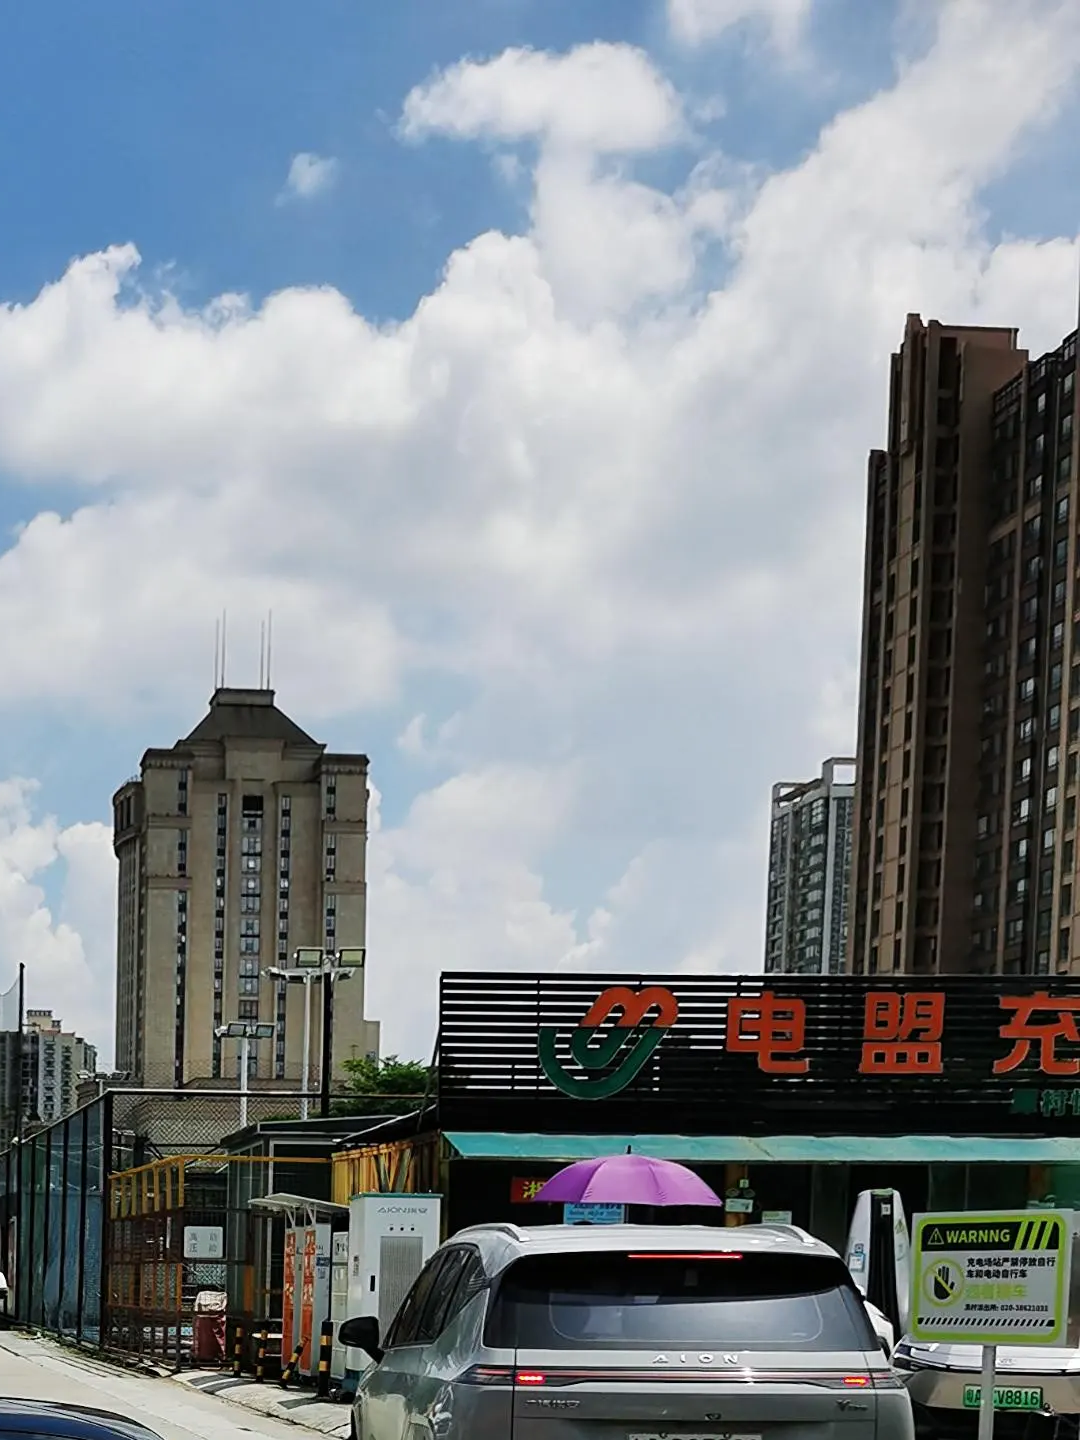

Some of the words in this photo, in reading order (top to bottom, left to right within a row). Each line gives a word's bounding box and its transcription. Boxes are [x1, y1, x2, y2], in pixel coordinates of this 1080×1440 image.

[724, 990, 1080, 1075] 电盟充
[946, 1229, 1010, 1244] WARNNG
[966, 1256, 1056, 1268] 充电场站严禁停放自行
[966, 1269, 1028, 1279] 车和电动自行车
[652, 1352, 741, 1365] AION
